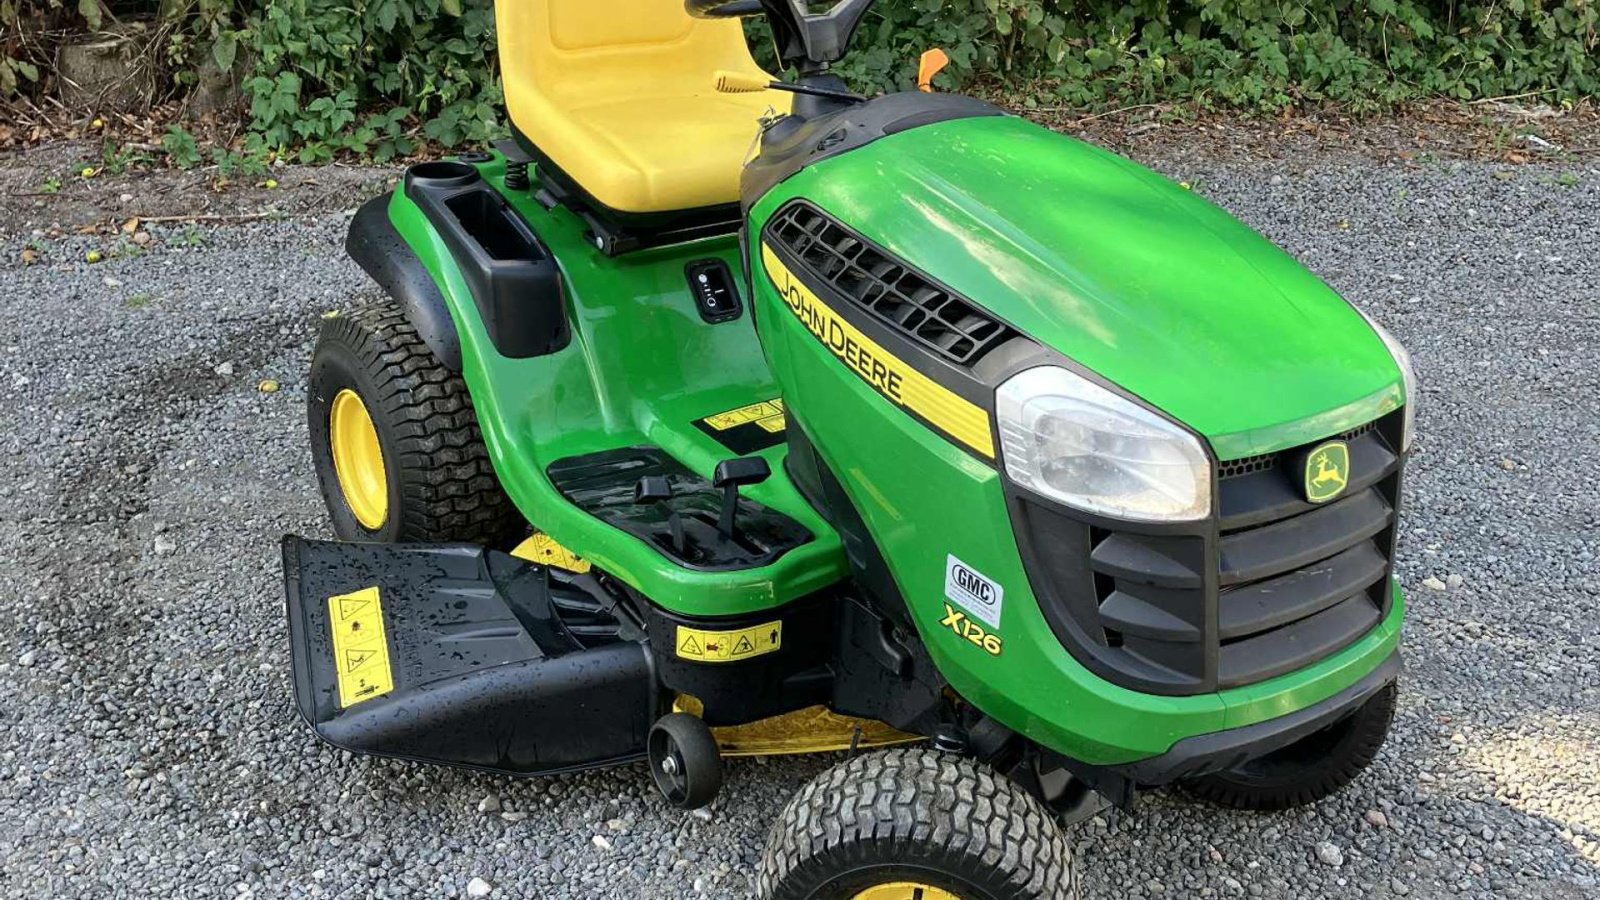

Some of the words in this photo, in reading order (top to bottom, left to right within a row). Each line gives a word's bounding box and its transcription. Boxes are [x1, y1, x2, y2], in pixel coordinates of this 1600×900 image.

[780, 273, 827, 338] JOHN
[830, 318, 904, 399] DEERE
[957, 568, 990, 601] GMC
[940, 602, 1002, 656] X126
